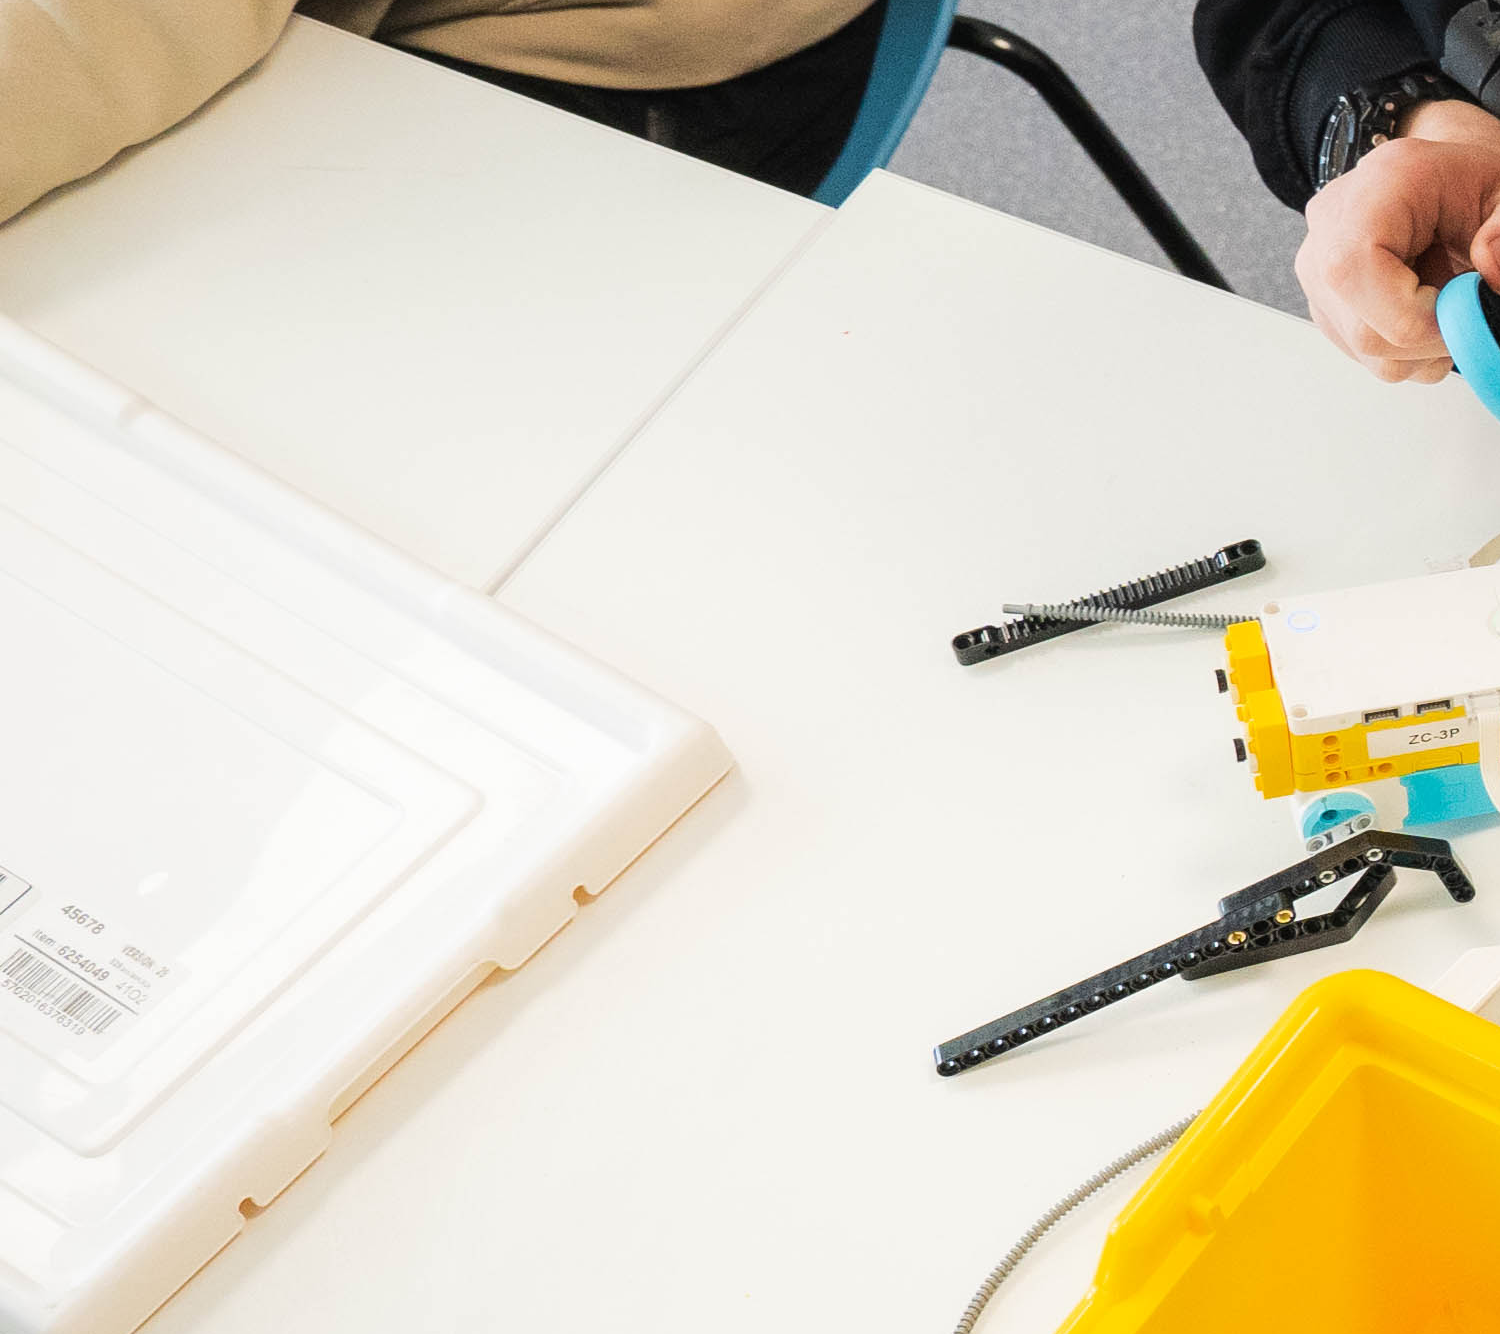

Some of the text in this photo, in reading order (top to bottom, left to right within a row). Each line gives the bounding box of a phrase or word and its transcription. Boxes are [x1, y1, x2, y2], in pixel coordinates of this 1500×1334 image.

[1408, 728, 1460, 745] ZC-3P
[61, 905, 105, 935] 45678
[57, 945, 110, 981] 6254049
[1, 978, 86, 1036] 5702016376319
